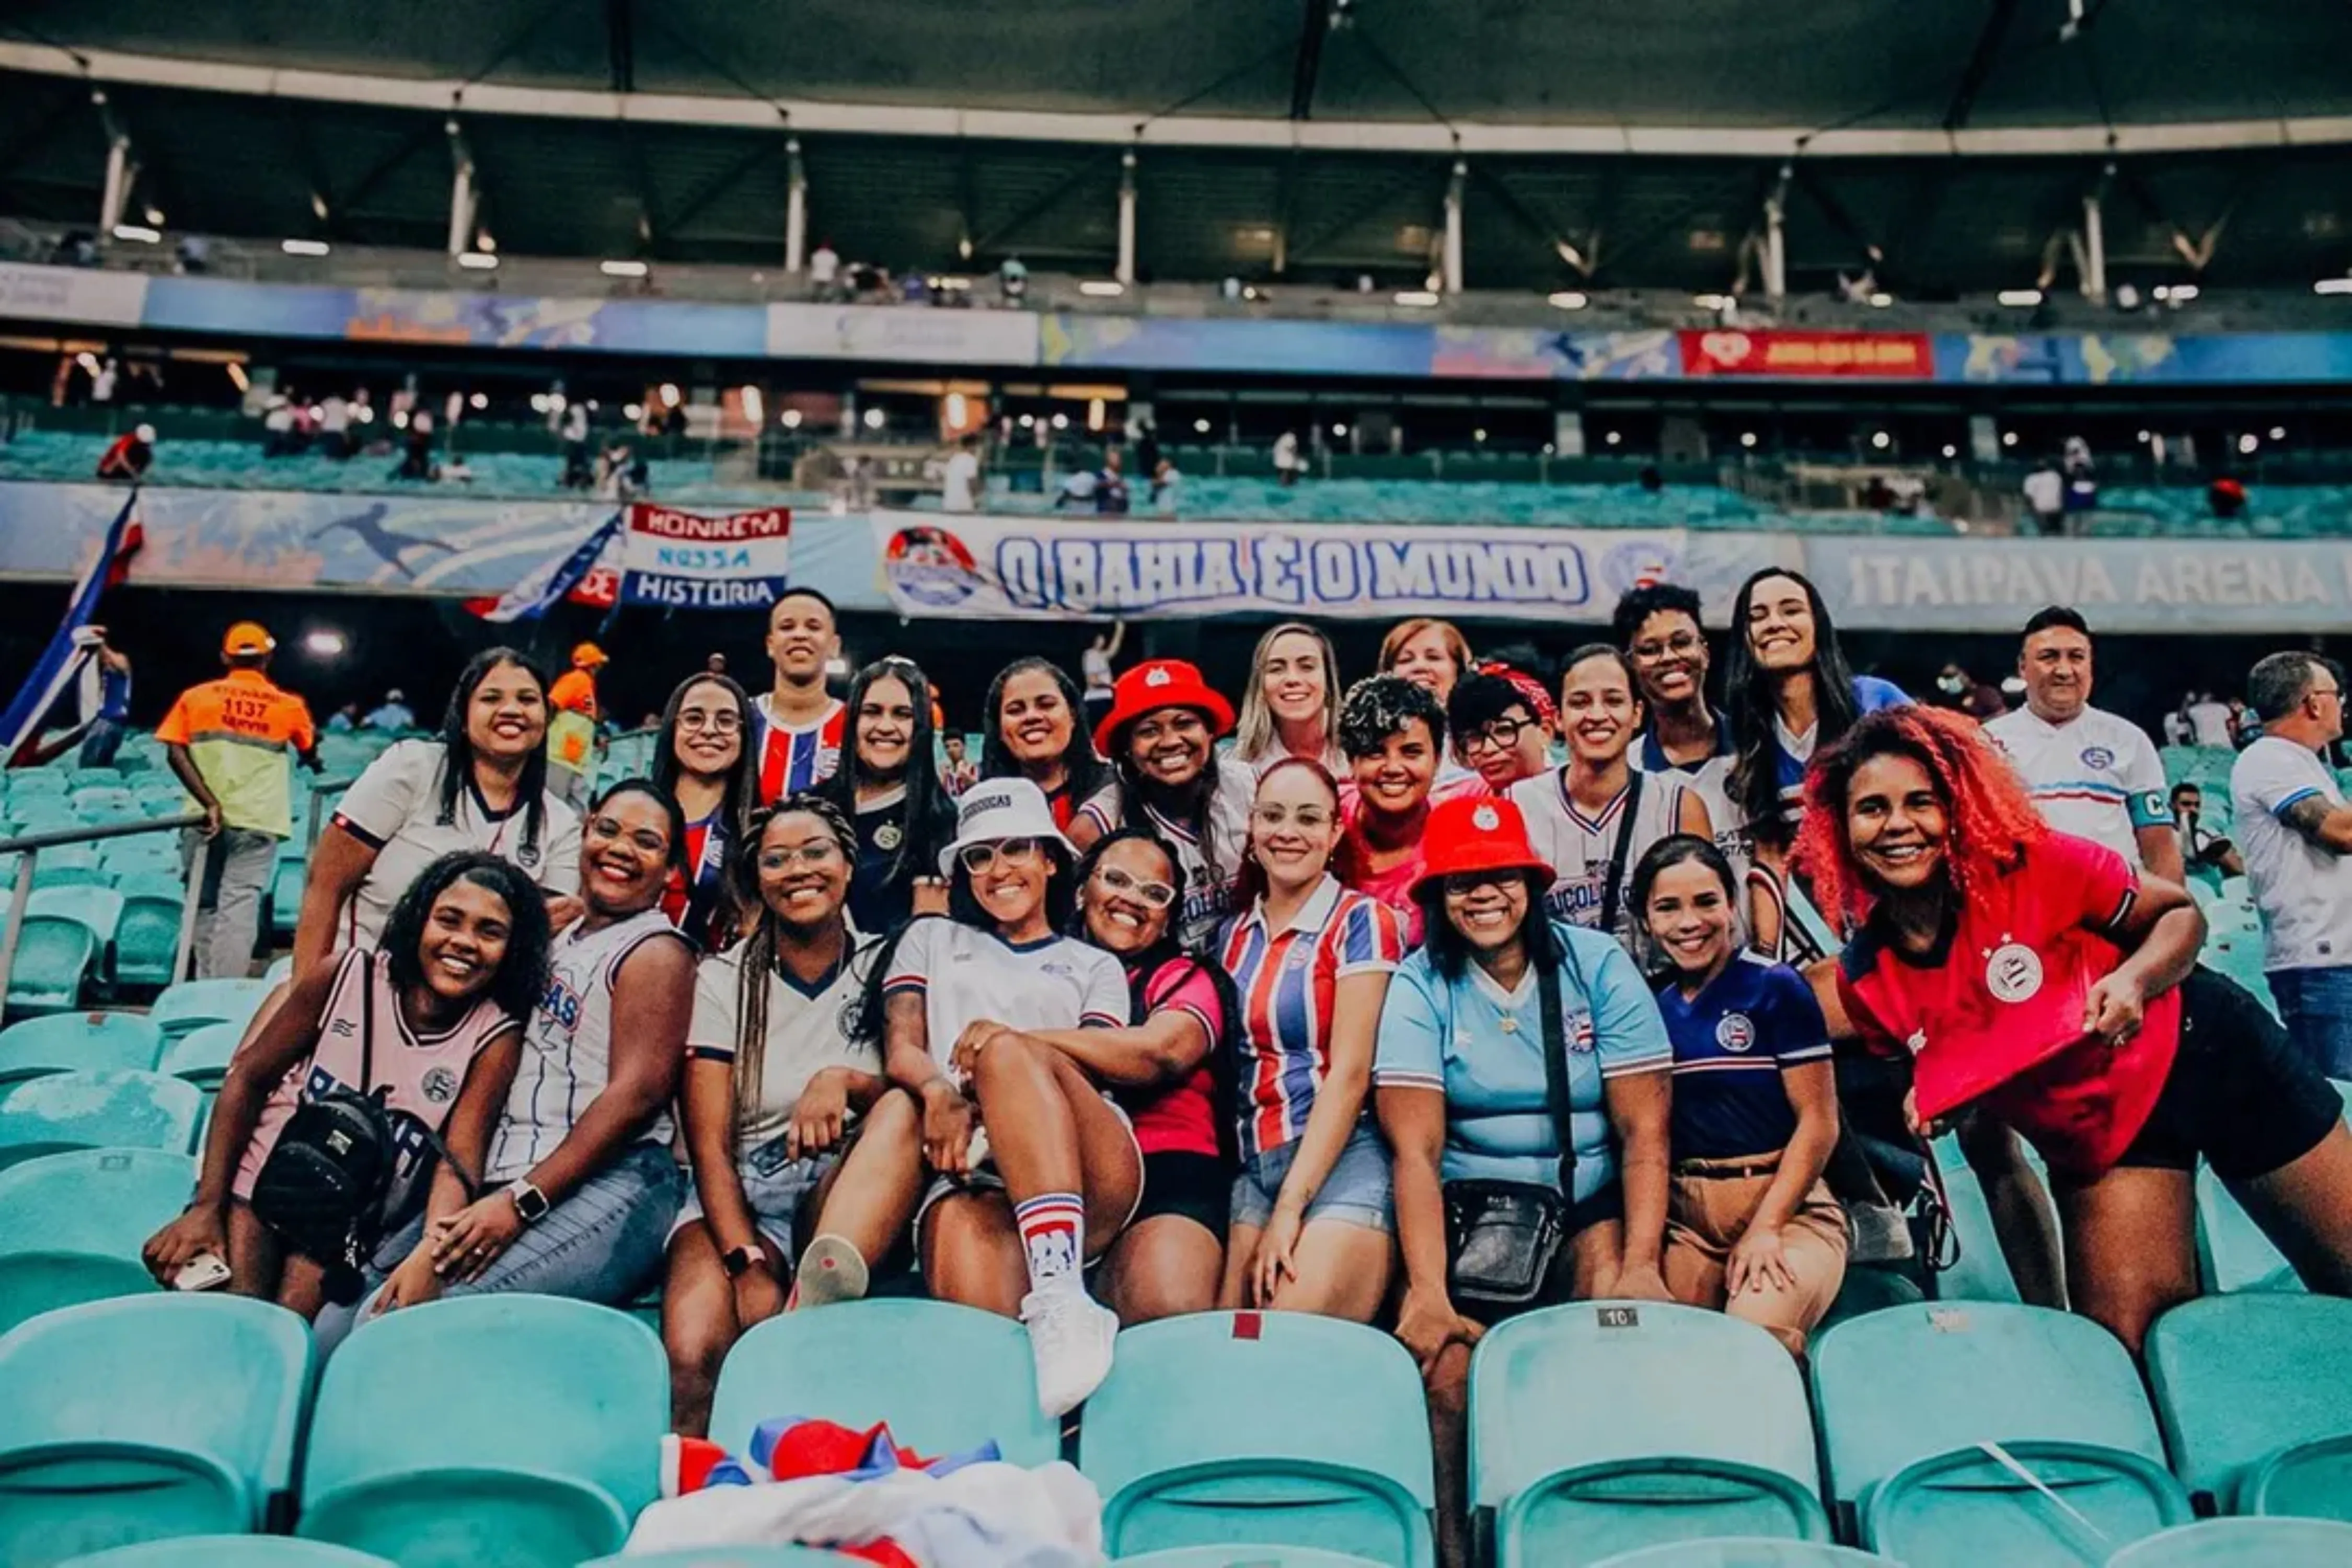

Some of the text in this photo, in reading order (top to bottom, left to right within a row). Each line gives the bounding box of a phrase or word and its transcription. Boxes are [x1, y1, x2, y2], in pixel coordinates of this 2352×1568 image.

[648, 511, 781, 537] HONREM
[657, 548, 751, 568] NOSSA
[997, 536, 1044, 608] O
[1052, 538, 1246, 613] BAHIA
[1310, 539, 1359, 603] O
[1365, 539, 1590, 605] MUNDO
[1848, 553, 2120, 606] ITAIPAVA
[2136, 556, 2333, 606] ARENA
[225, 698, 268, 720] 1137
[2145, 793, 2164, 815] C
[1606, 1310, 1628, 1325] 10
